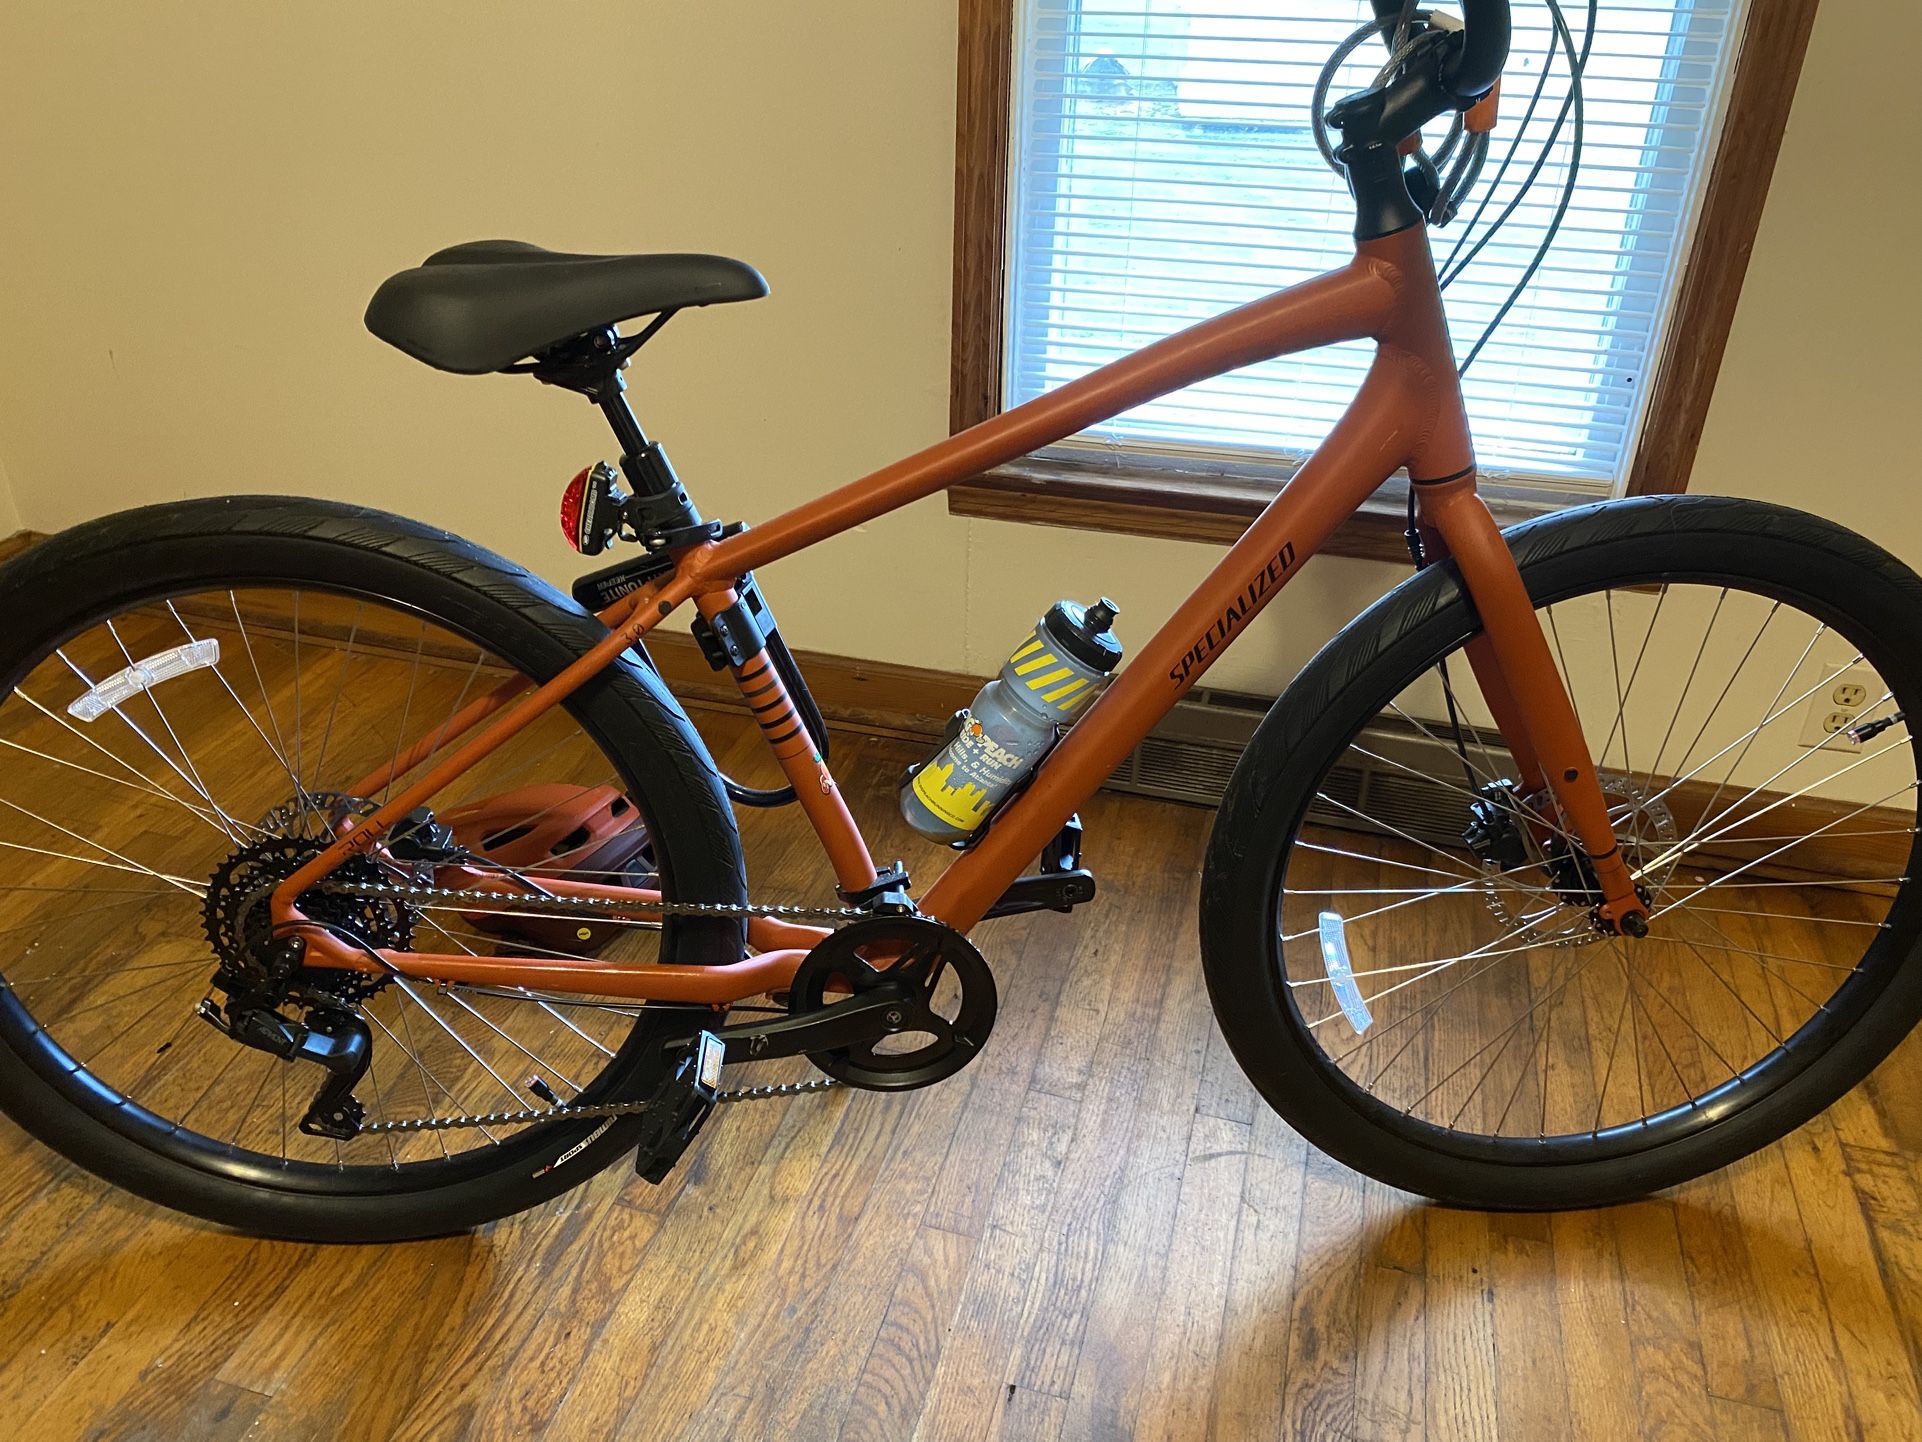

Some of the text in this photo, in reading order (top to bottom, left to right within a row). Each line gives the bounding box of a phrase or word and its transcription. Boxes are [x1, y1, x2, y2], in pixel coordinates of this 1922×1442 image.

[1169, 541, 1296, 690] SPECIALIZED
[977, 734, 1024, 770] PEACH
[980, 753, 1002, 770] RUN
[970, 761, 980, 770] &
